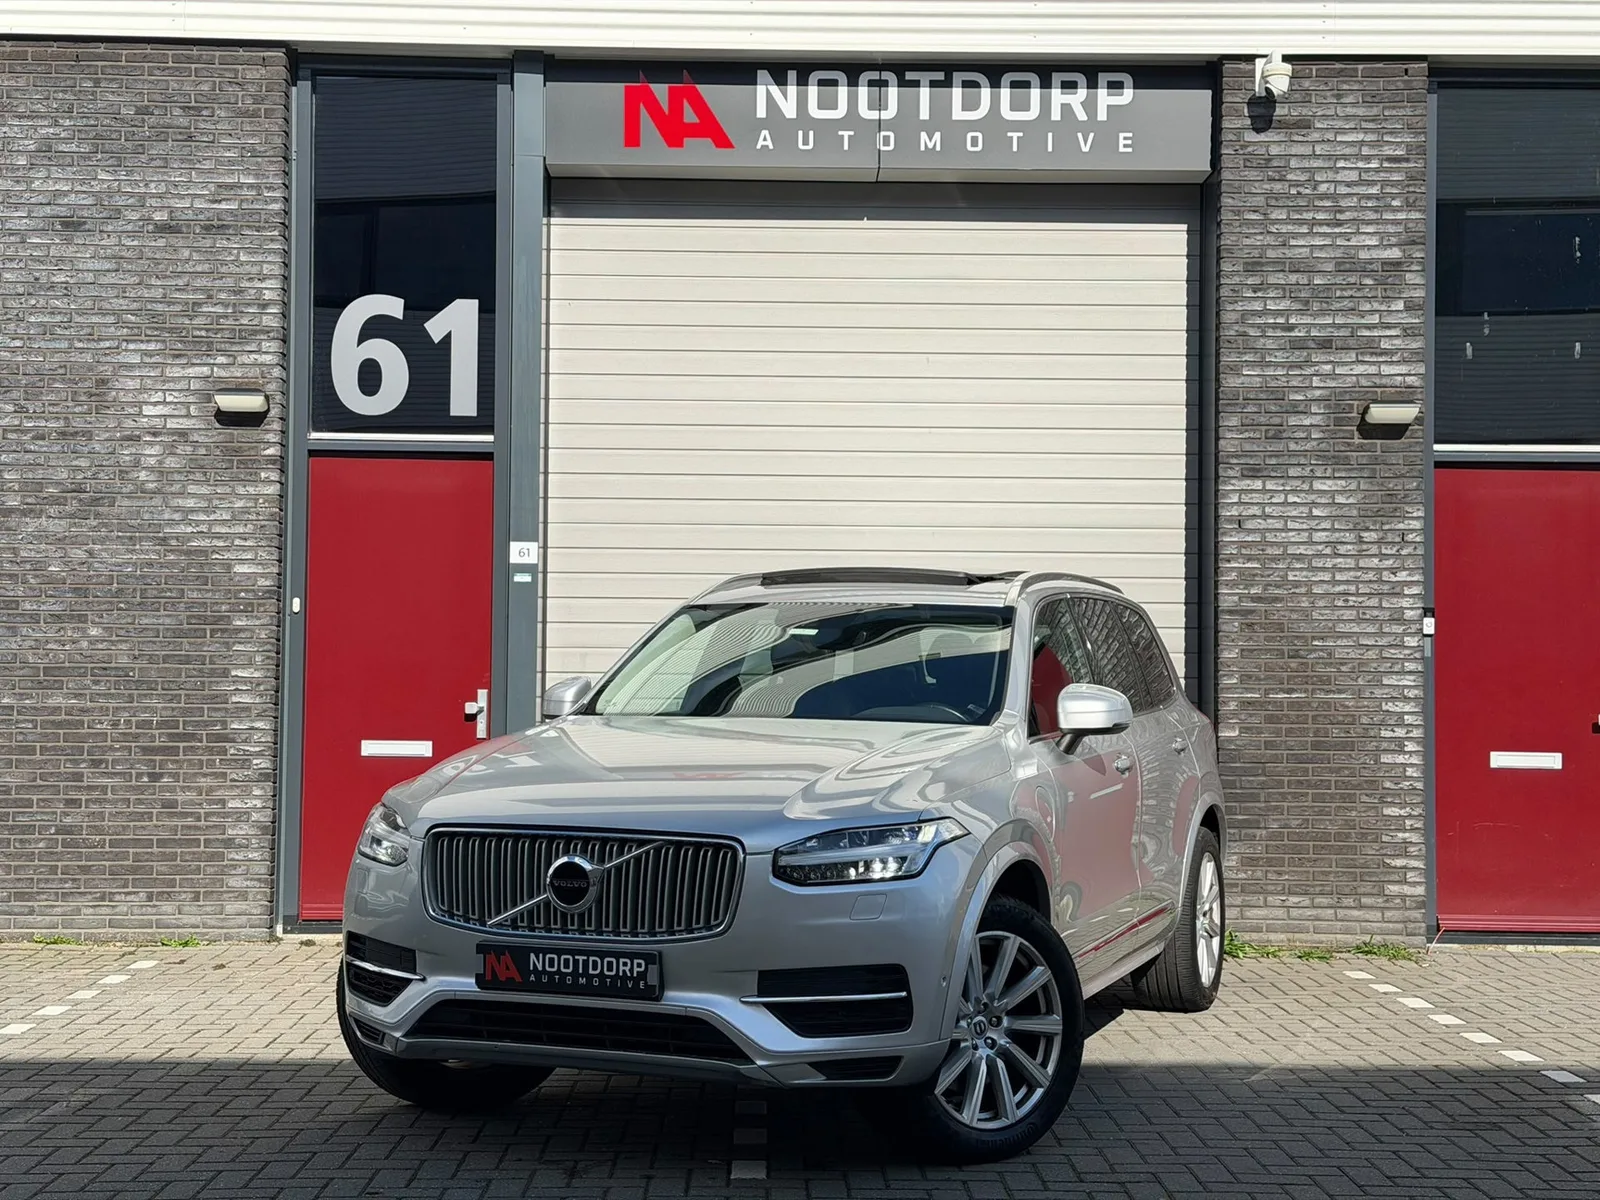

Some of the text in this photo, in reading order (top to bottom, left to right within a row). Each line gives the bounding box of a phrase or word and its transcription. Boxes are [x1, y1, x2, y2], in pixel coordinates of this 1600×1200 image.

[756, 70, 1135, 121] NOOTDORP
[756, 129, 1135, 153] AUTOMOTIVE
[330, 293, 480, 417] 61
[518, 547, 531, 559] 61
[552, 880, 588, 888] VOLVO
[529, 952, 645, 978] NOOTDORP
[529, 974, 645, 989] AUTOMOTIVE
